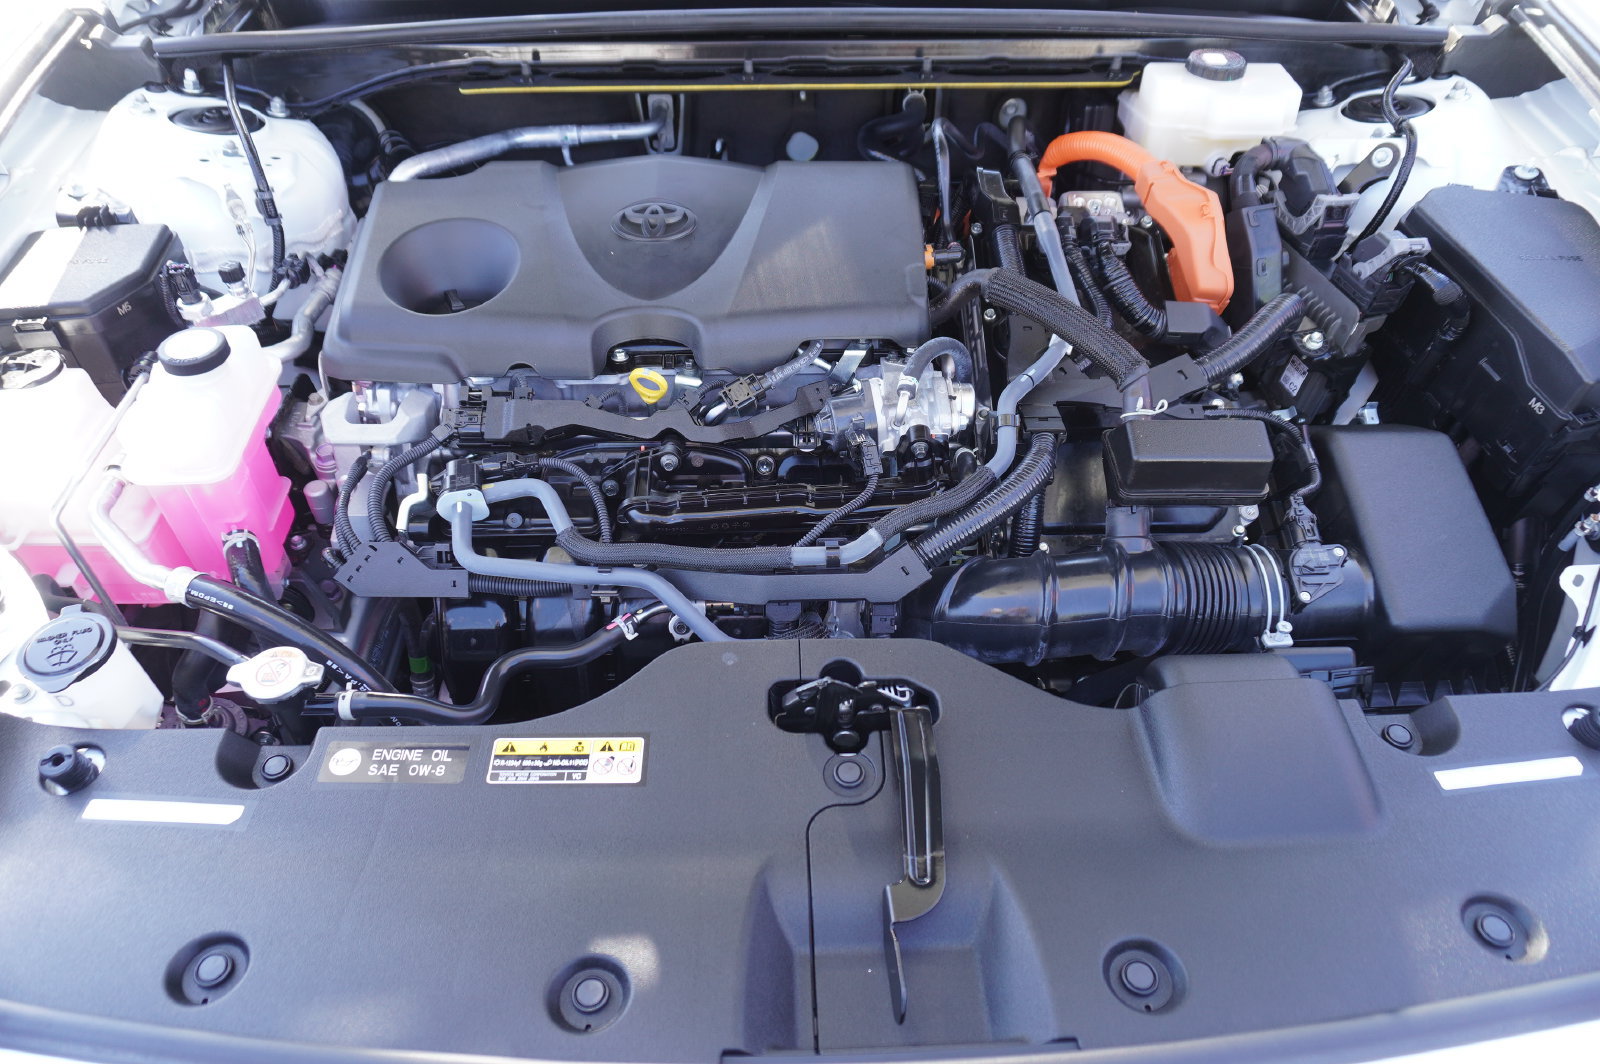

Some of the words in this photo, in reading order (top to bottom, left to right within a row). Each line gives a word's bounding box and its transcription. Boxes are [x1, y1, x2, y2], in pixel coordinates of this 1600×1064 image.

[117, 301, 132, 316] M5
[1527, 397, 1546, 415] M3
[372, 749, 423, 761] ENGINE
[431, 750, 453, 762] OIL
[367, 764, 400, 776] SAE
[408, 765, 446, 776] 0W-8
